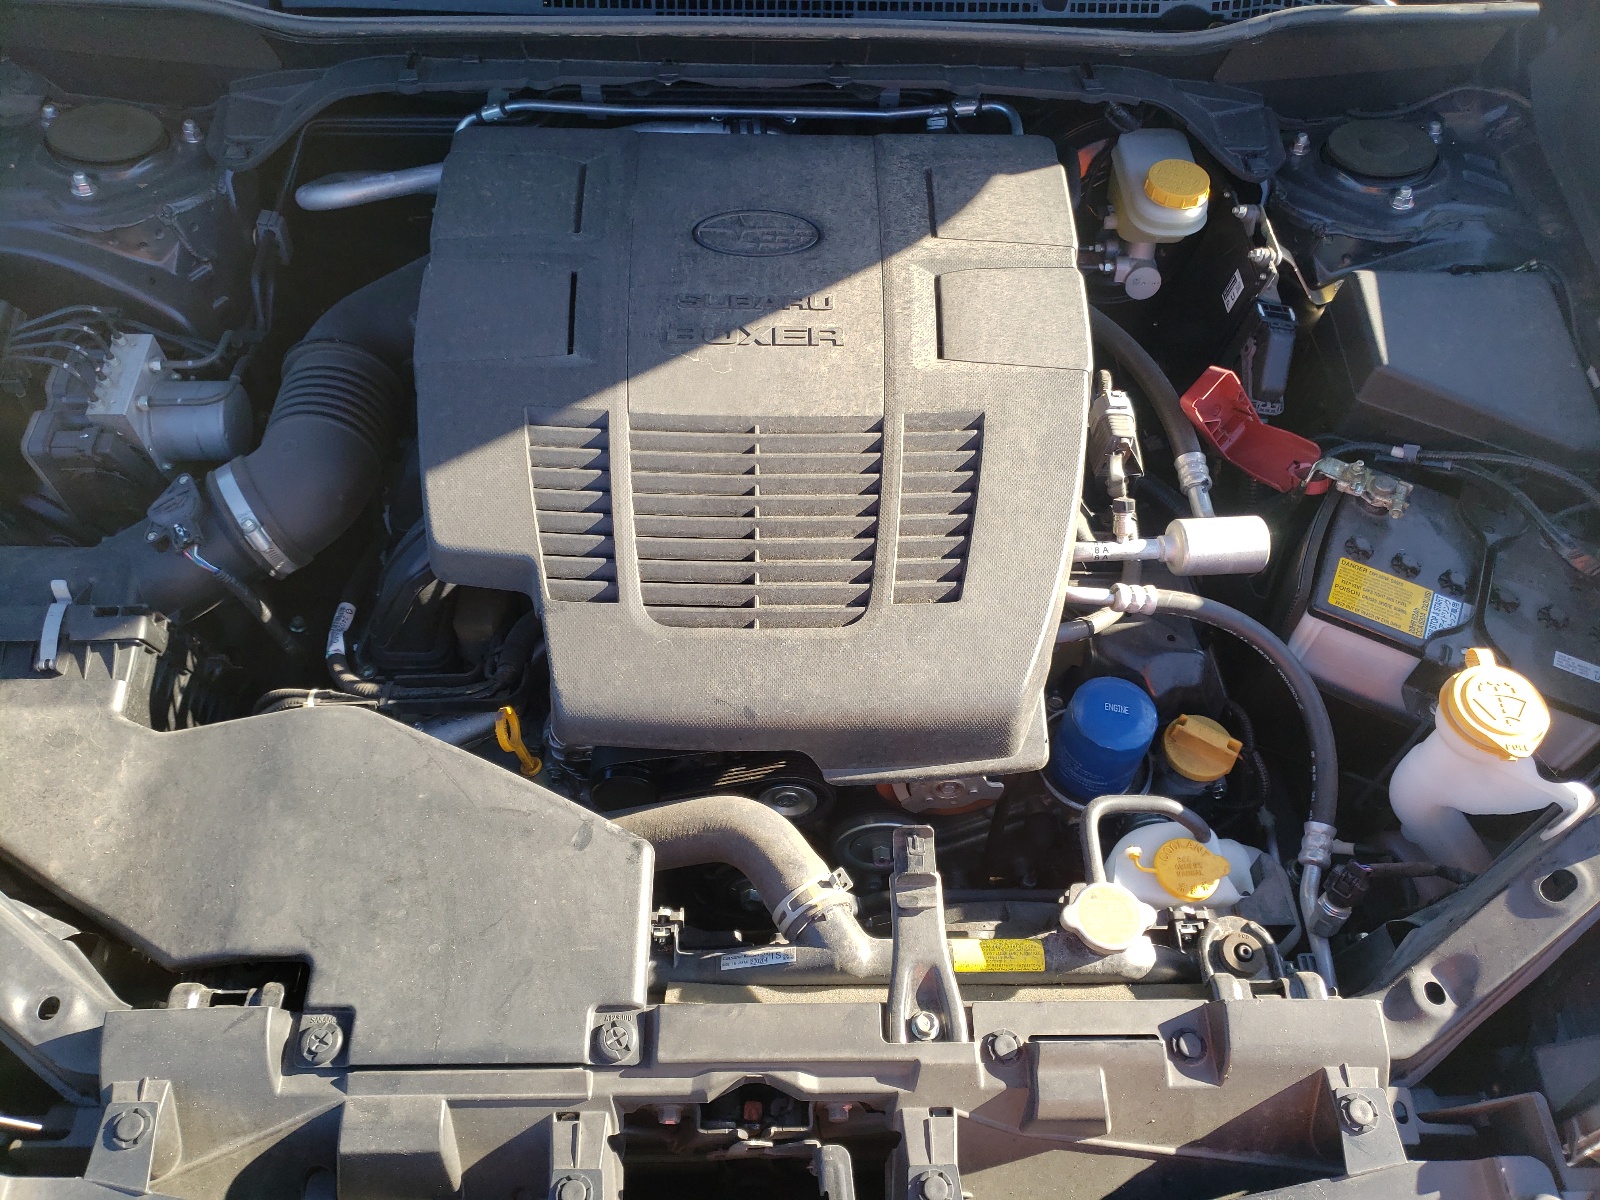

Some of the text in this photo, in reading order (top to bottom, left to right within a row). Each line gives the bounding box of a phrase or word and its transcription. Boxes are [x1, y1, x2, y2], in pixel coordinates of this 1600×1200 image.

[677, 293, 835, 312] SUBARU
[663, 325, 845, 347] BOXER
[1340, 559, 1368, 572] DANGER
[1334, 583, 1360, 596] POISON
[1104, 702, 1129, 715] ENGINE
[1159, 841, 1211, 862] COOLANT
